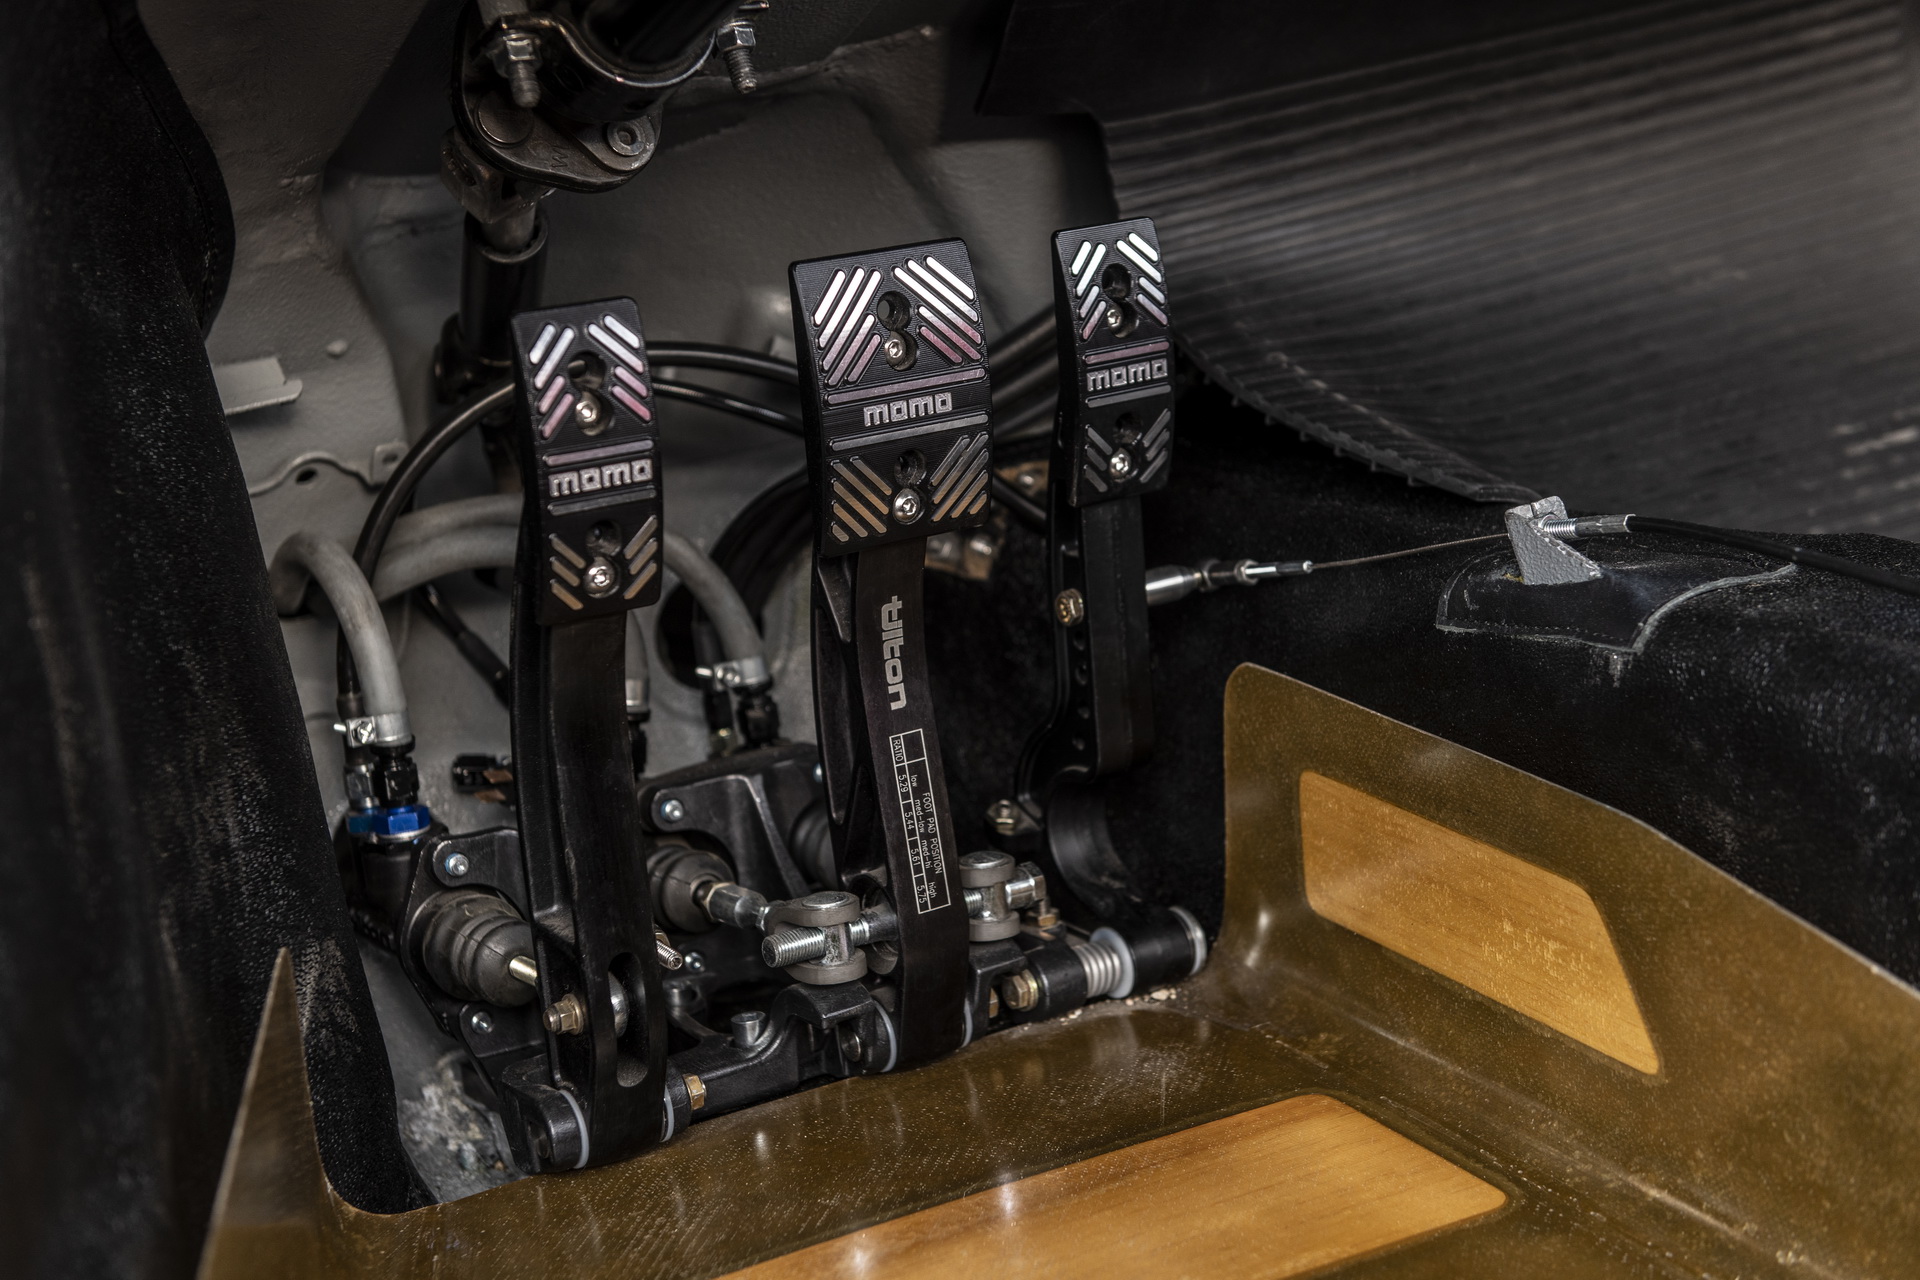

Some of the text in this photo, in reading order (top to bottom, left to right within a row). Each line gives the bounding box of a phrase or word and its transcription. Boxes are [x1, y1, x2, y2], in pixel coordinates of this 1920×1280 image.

[863, 392, 953, 427] momo
[1086, 358, 1169, 392] momo
[548, 458, 653, 498] momo
[881, 595, 907, 711] tilton
[892, 739, 928, 904] RATIO 5.29 5.44 5.61 5.75
[910, 774, 938, 899] low med-low med-hi high
[922, 792, 943, 874] FOOT PAD POSITION
